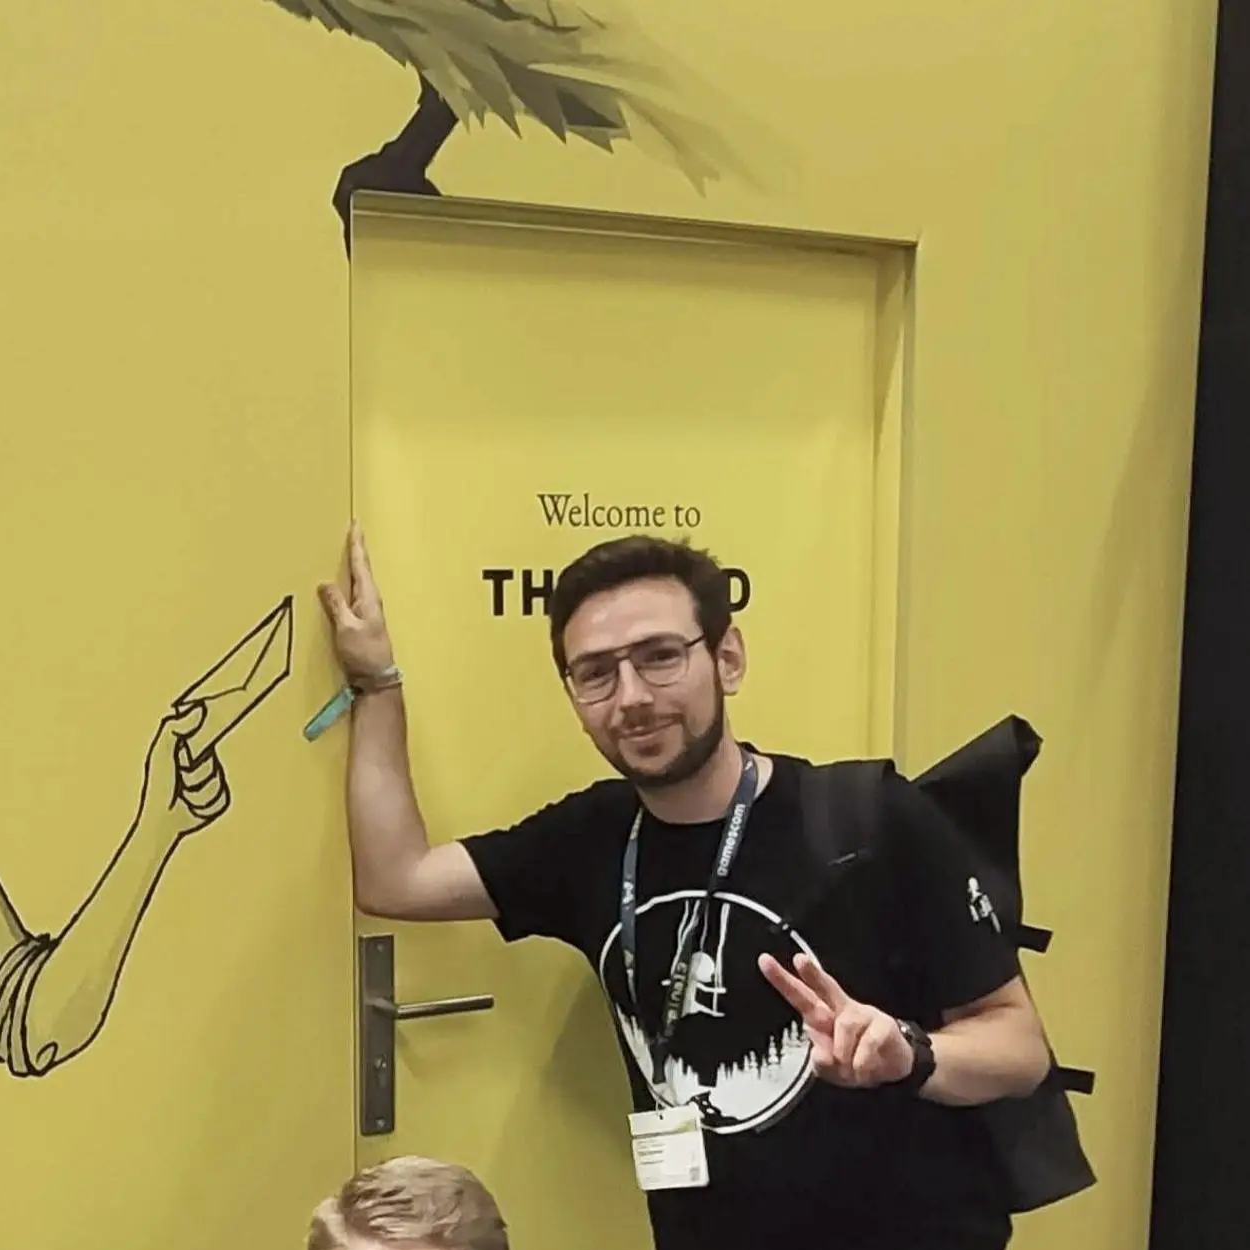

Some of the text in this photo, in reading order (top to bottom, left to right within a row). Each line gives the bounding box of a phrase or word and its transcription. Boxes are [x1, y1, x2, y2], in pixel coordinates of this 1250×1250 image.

[537, 493, 701, 528] Welcome to
[716, 803, 746, 876] gamescom
